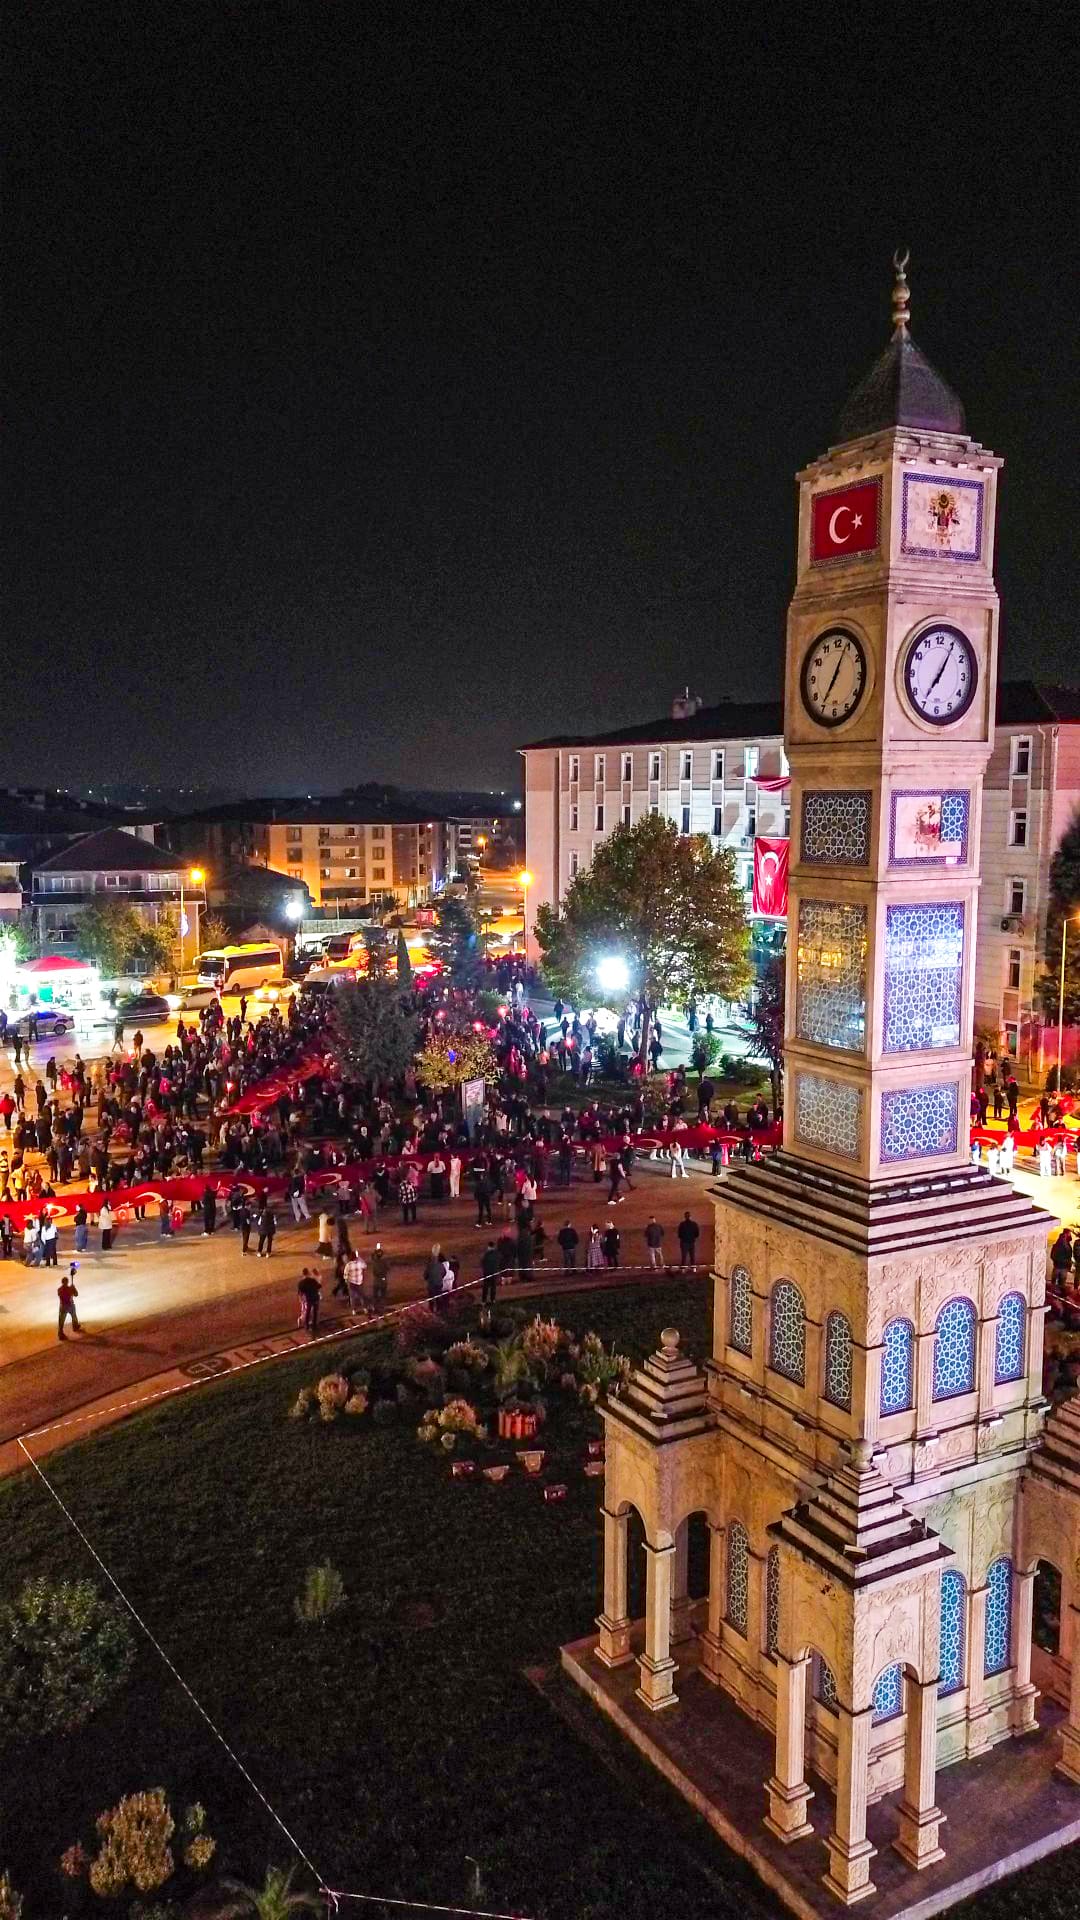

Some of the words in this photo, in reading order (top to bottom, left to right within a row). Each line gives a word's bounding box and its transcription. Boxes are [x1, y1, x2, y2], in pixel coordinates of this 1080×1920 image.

[834, 640, 842, 648] 12
[924, 640, 930, 648] 11
[936, 636, 944, 645] 12
[822, 644, 830, 654] 11
[846, 642, 850, 651] 1
[855, 654, 861, 663] 2
[914, 652, 922, 660] 10
[958, 654, 964, 664] 2
[814, 658, 822, 666] 10
[856, 672, 862, 680] 3
[910, 669, 916, 678] 9
[960, 672, 966, 682] 3
[810, 676, 816, 684] 9
[852, 688, 858, 696] 4
[912, 687, 918, 696] 8
[956, 688, 962, 698] 4
[814, 692, 818, 702] 8
[820, 704, 826, 714] 7
[844, 702, 850, 712] 5
[921, 700, 926, 710] 7
[947, 702, 952, 711] 5
[832, 708, 837, 717] 6
[934, 706, 940, 714] 6
